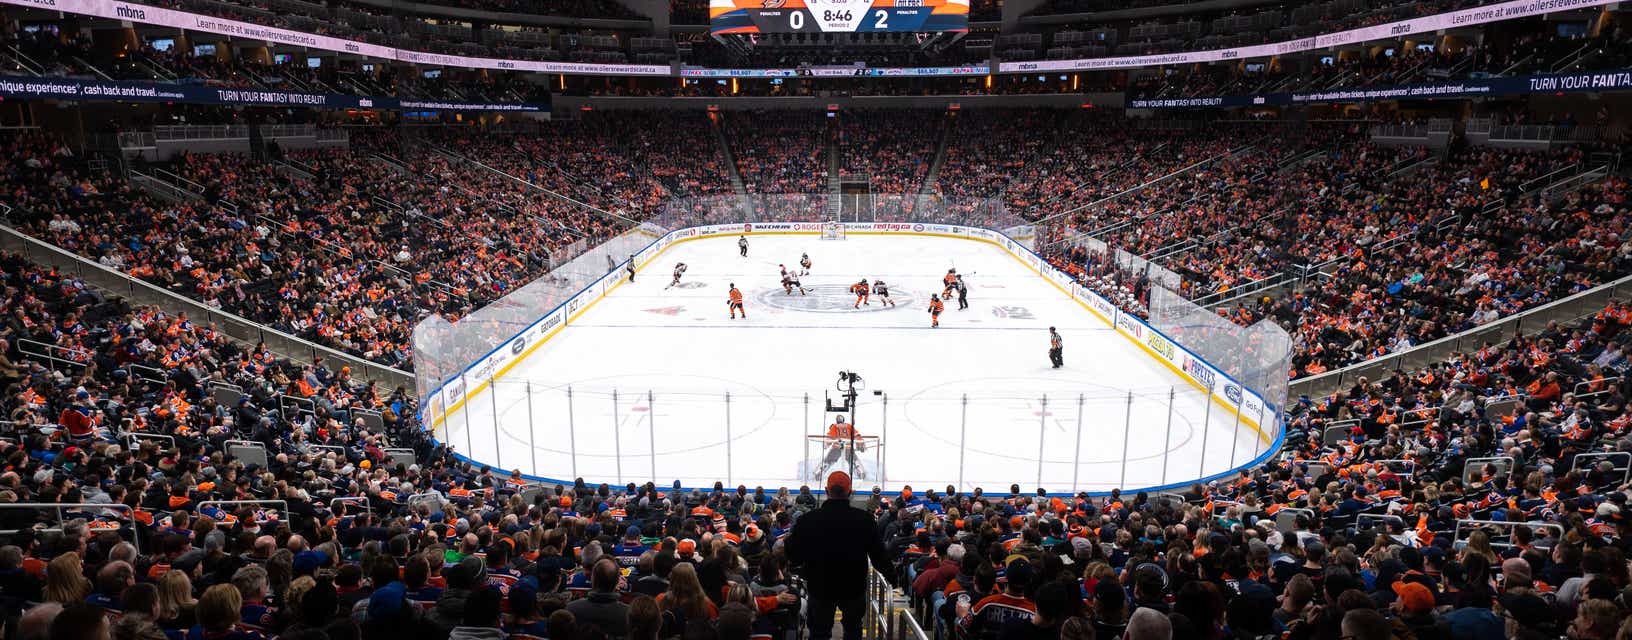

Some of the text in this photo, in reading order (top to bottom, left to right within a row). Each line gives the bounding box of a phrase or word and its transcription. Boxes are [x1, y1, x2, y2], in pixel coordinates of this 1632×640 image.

[116, 5, 146, 20] mbna
[824, 10, 852, 21] 8:46
[874, 10, 888, 28] 2
[1452, 14, 1472, 24] Learn
[1473, 10, 1493, 20] more
[1495, 8, 1504, 17] at
[195, 17, 216, 29] Learn
[218, 22, 234, 32] more
[236, 26, 242, 34] at
[790, 11, 804, 29] 0
[1391, 24, 1410, 35] mbna
[345, 43, 360, 52] mbna
[1222, 50, 1238, 58] mbna
[1530, 73, 1632, 90] TURN YOUR FANTA
[84, 86, 101, 95] cash
[104, 86, 121, 96] back
[122, 87, 135, 96] and
[136, 88, 158, 97] travel.
[1411, 86, 1422, 94] cash
[1424, 86, 1436, 94] back
[1436, 84, 1447, 93] and
[218, 90, 326, 104] TURN YOUR FANTASY INTO REALITY
